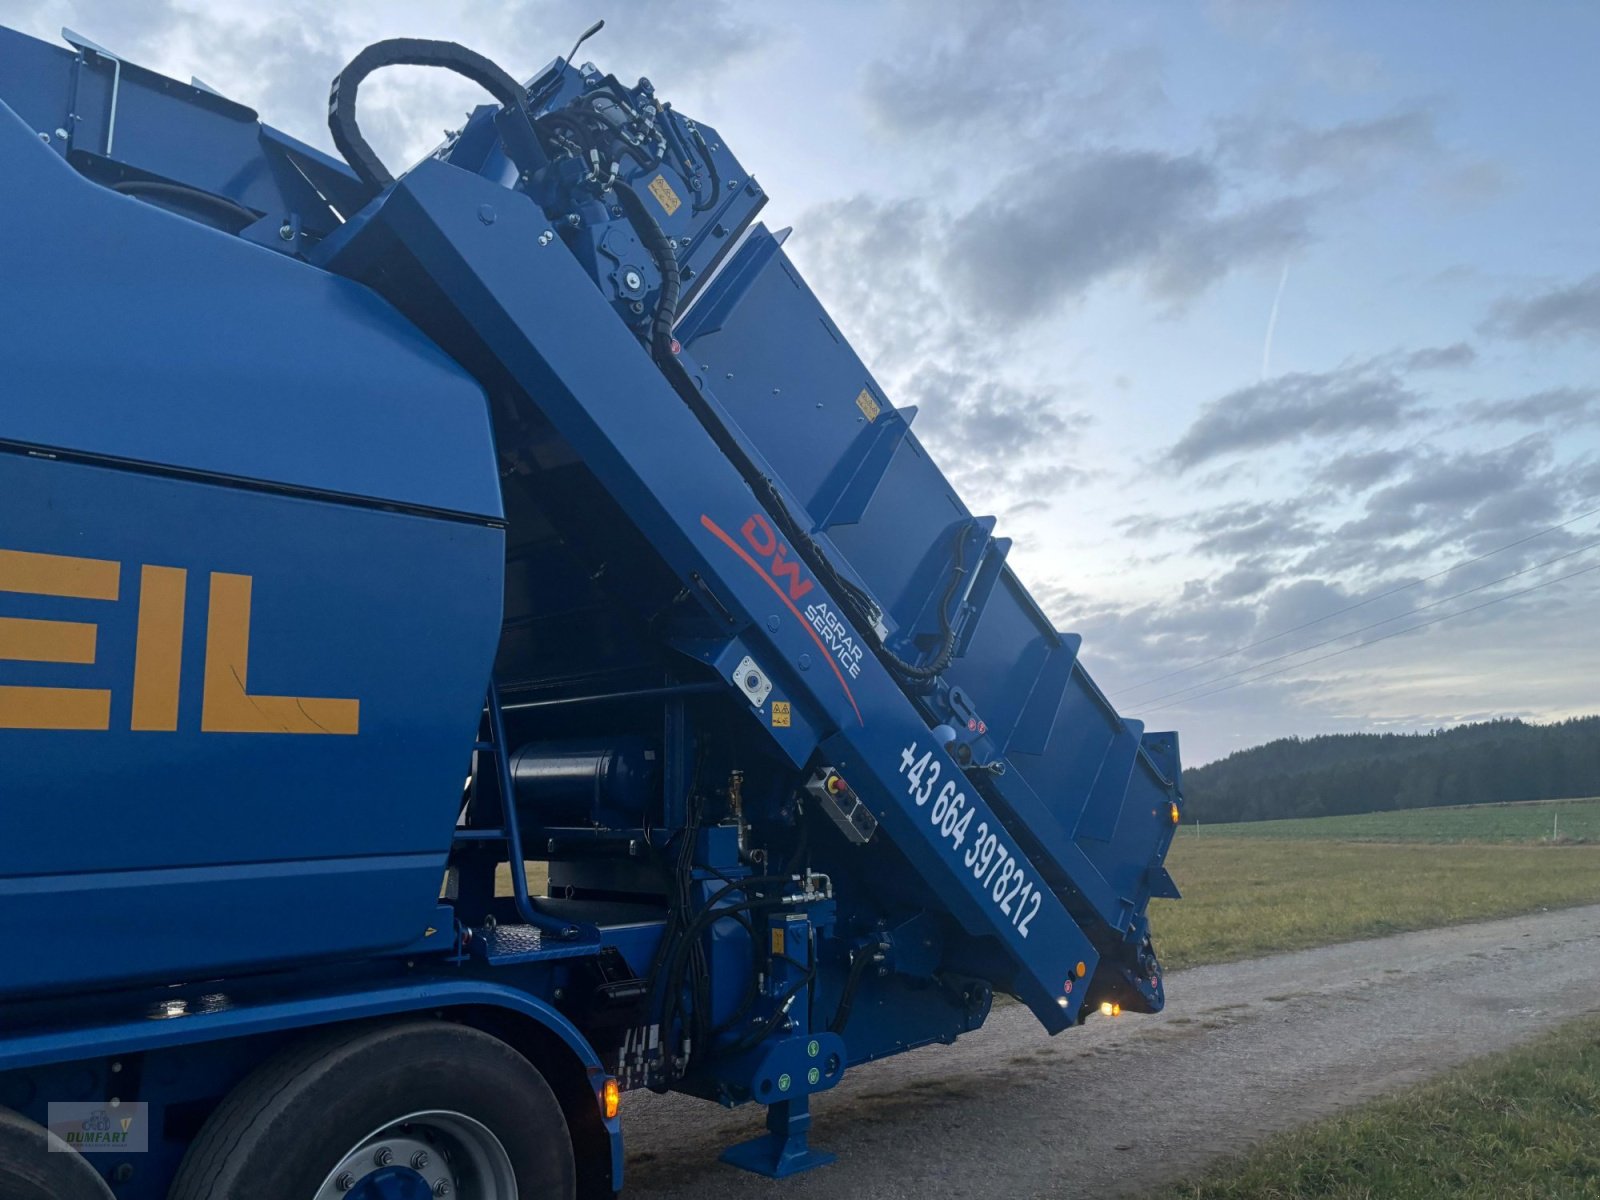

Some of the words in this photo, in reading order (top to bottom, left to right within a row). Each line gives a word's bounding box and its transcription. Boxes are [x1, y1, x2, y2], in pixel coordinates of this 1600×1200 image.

[804, 604, 861, 680] SERVICE
[815, 602, 863, 663] AGRAR
[899, 741, 941, 806] +43
[931, 780, 976, 850] 664
[964, 822, 1042, 939] 3978212
